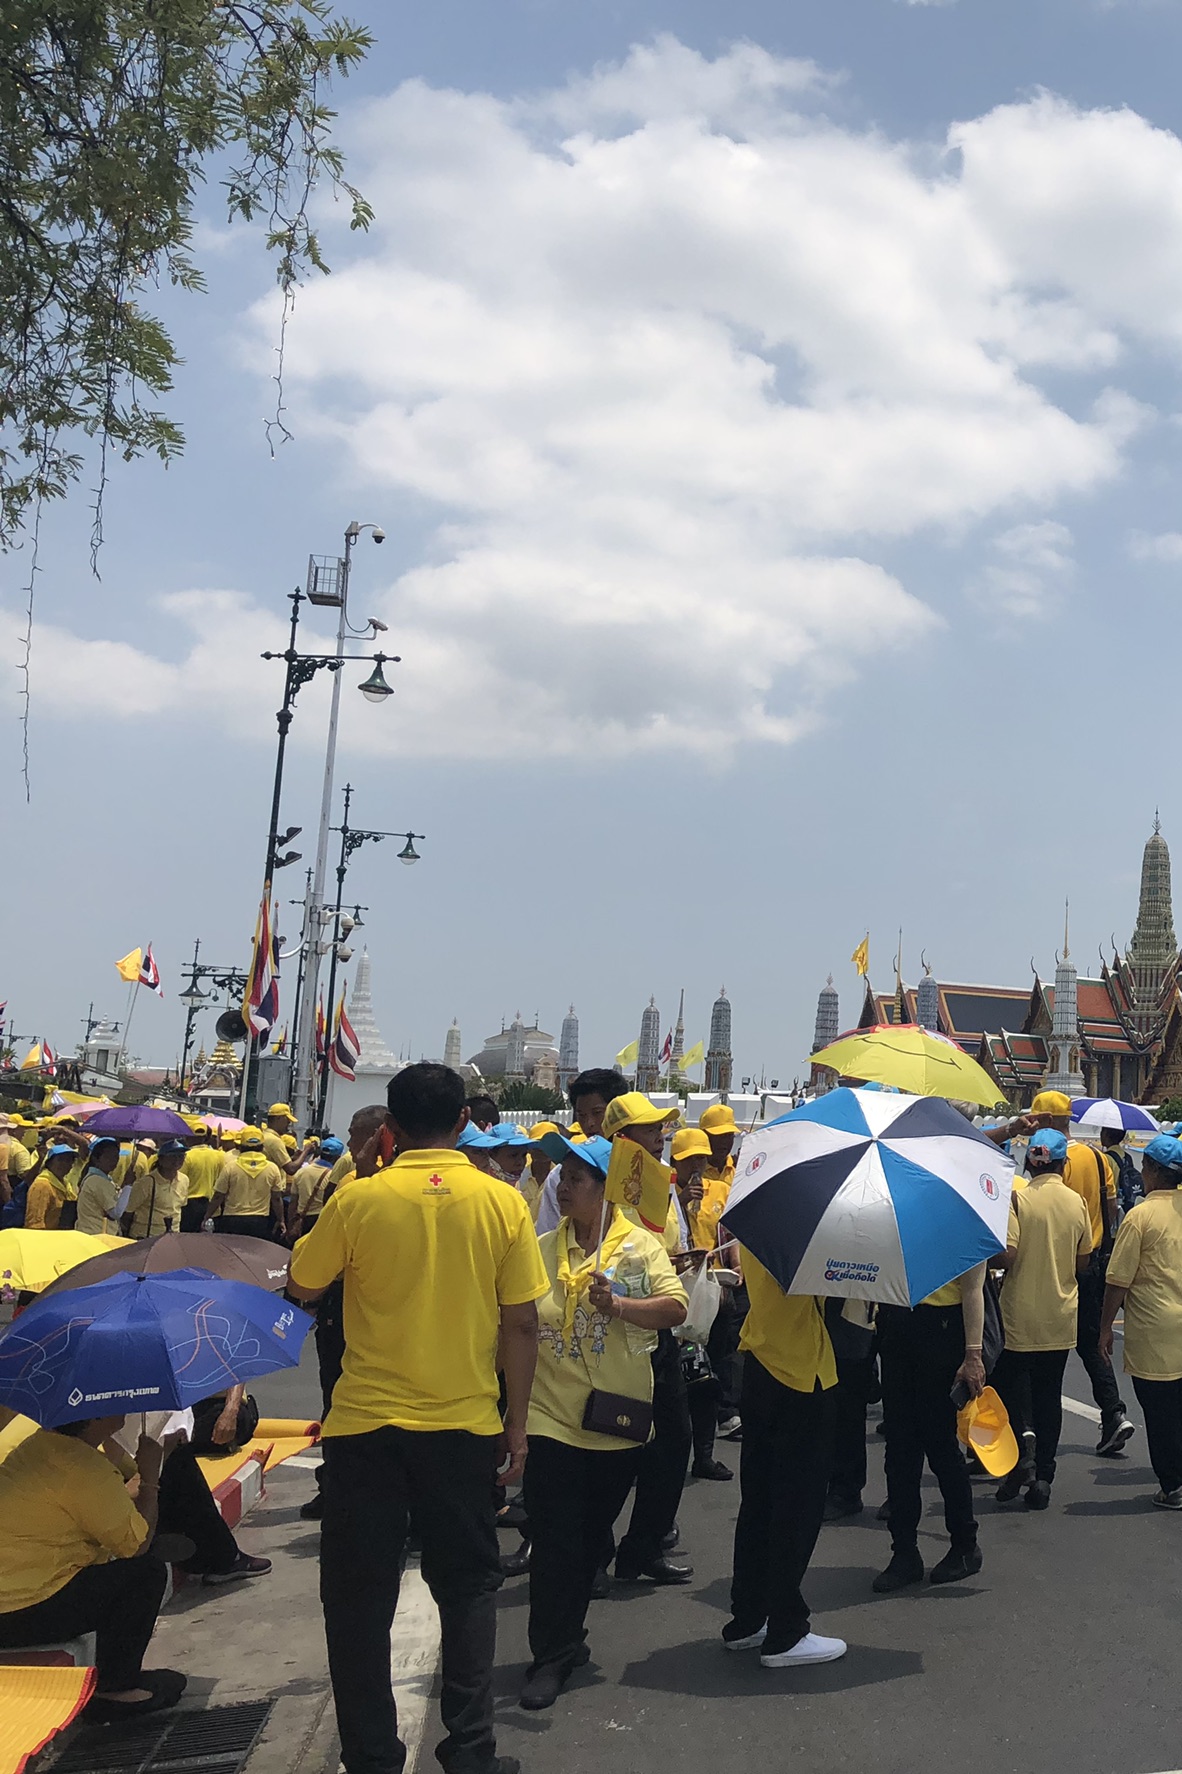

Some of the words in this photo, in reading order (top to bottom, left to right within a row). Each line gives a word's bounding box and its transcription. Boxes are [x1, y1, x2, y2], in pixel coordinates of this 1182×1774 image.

[85, 1387, 160, 1401] ธนาคารกรุงเทพ
